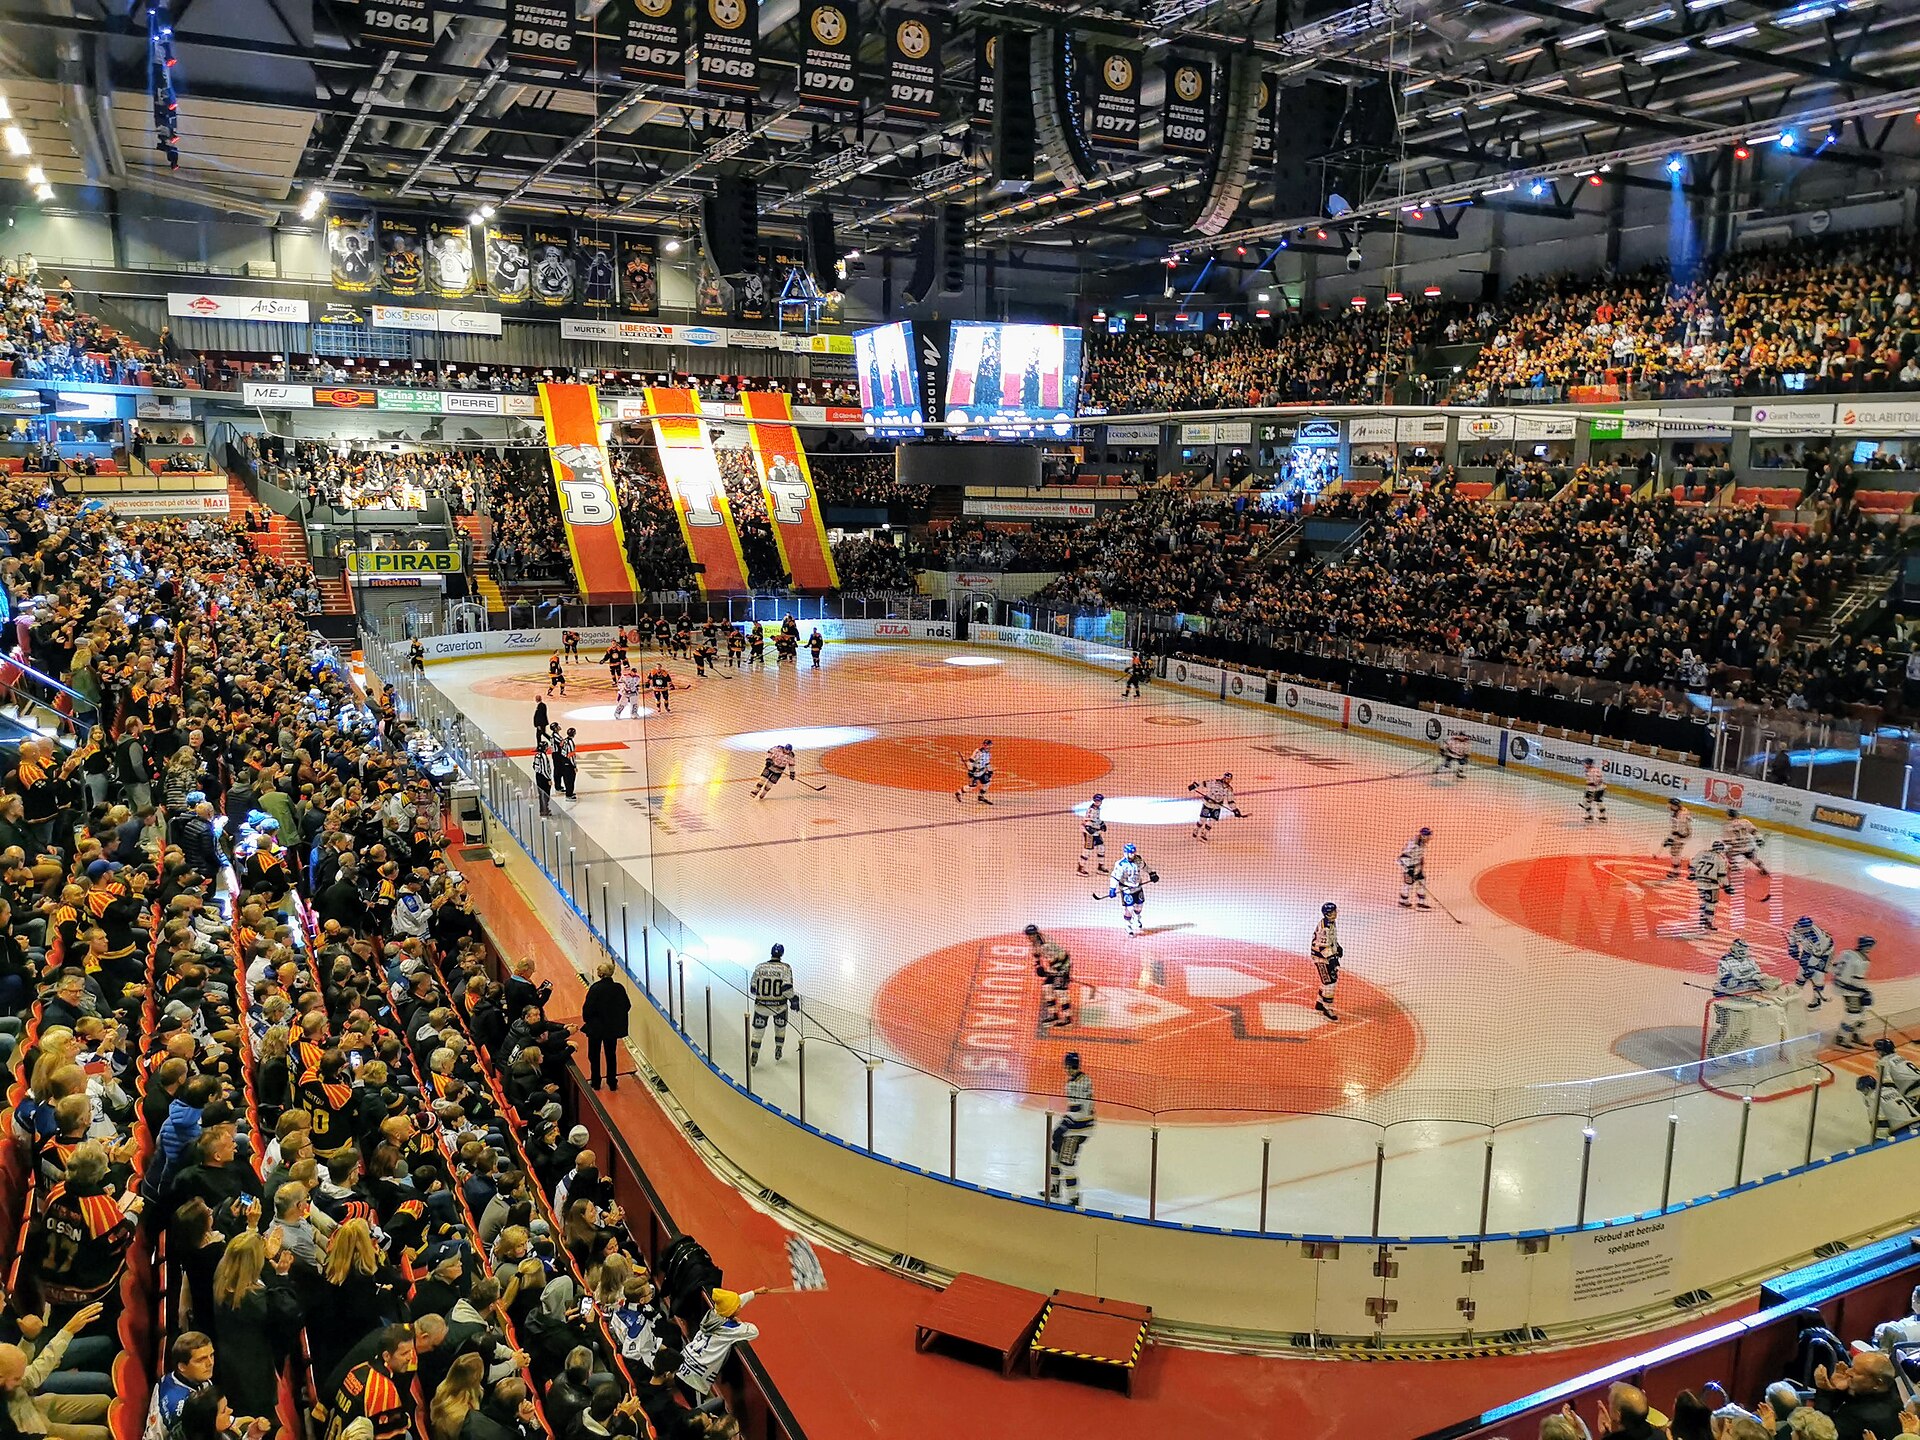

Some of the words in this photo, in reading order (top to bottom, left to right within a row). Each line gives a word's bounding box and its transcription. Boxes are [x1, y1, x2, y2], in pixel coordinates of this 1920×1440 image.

[515, 4, 567, 18] SVENSKA
[364, 9, 429, 33] 1964
[628, 20, 677, 35] SVENSKA
[512, 28, 571, 51] 1966
[703, 32, 751, 46] SVENSKA
[625, 44, 680, 66] 1967
[806, 49, 851, 62] SVENSKA
[701, 56, 755, 78] 1968
[892, 61, 934, 75] SVENSKA
[804, 71, 854, 92] 1970
[891, 84, 934, 104] 1971
[1096, 115, 1137, 132] 1977
[1166, 124, 1206, 142] 1980
[251, 300, 297, 315] AnSan's
[573, 325, 607, 335] MURTEK
[619, 323, 657, 333] LIBERGS
[679, 332, 722, 341] BYGGTEC
[254, 388, 288, 399] MEJ
[380, 389, 413, 400] Carina
[415, 391, 440, 401] Städ
[926, 371, 937, 423] MIDROC
[450, 399, 495, 408] PIERRE
[1769, 412, 1788, 421] Grant
[559, 480, 616, 526] B
[676, 480, 724, 527] I
[766, 480, 811, 525] F
[375, 554, 451, 570] PIRAB
[876, 624, 910, 636] JULA
[926, 626, 952, 638] nds
[979, 629, 1021, 643] SUBWAY
[435, 640, 483, 653] Caverion
[1602, 758, 1691, 791] BILBOLAGET
[1699, 860, 1715, 875] 77
[756, 978, 783, 997] 100
[962, 945, 1029, 1075] BAUHAUS
[1593, 1229, 1623, 1244] Förbud
[1624, 1229, 1635, 1240] att
[1636, 1222, 1666, 1237] beträda
[1607, 1239, 1650, 1255] spelplanen
